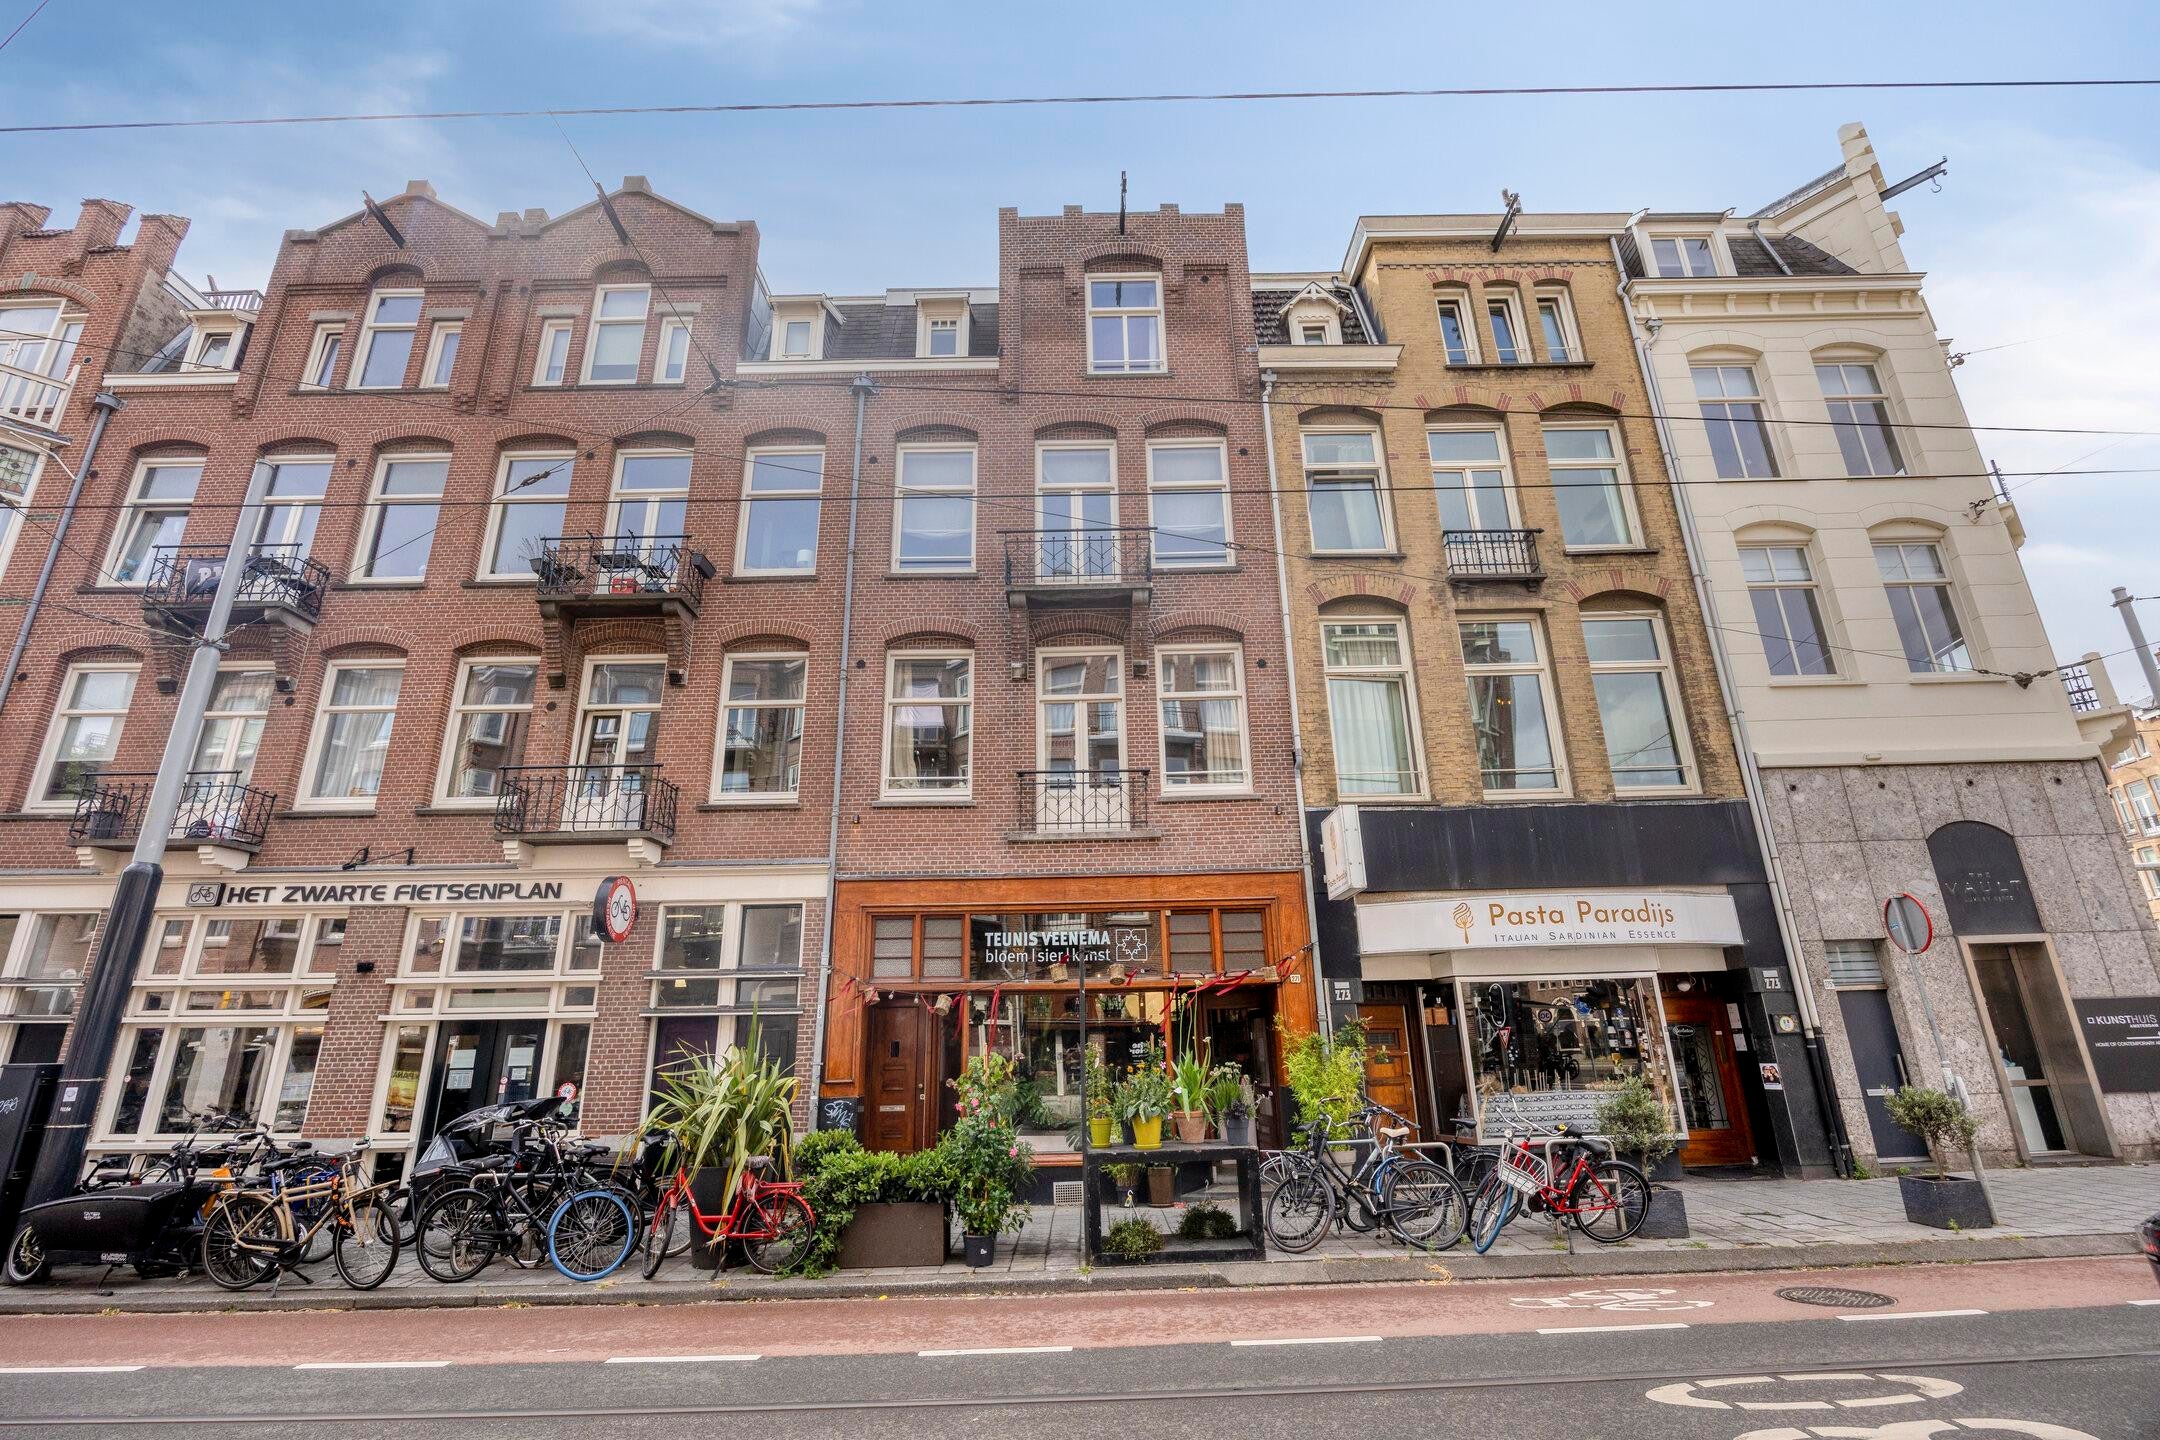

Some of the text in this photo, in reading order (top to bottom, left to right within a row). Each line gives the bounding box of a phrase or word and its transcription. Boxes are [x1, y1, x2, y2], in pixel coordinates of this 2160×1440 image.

[227, 882, 563, 903] HET ZWARTE FIETSENPLAN
[1488, 898, 1674, 928] Pasta Paradijs
[984, 930, 1110, 946] TEUNIS VEENEMA
[1494, 930, 1676, 942] ITALIAN SARDINIAN ESSENCE
[985, 949, 1028, 963] bloem
[1765, 978, 1781, 989] 273
[1334, 989, 1351, 1000] 273
[2096, 1014, 2158, 1024] KUNSTHUIS
